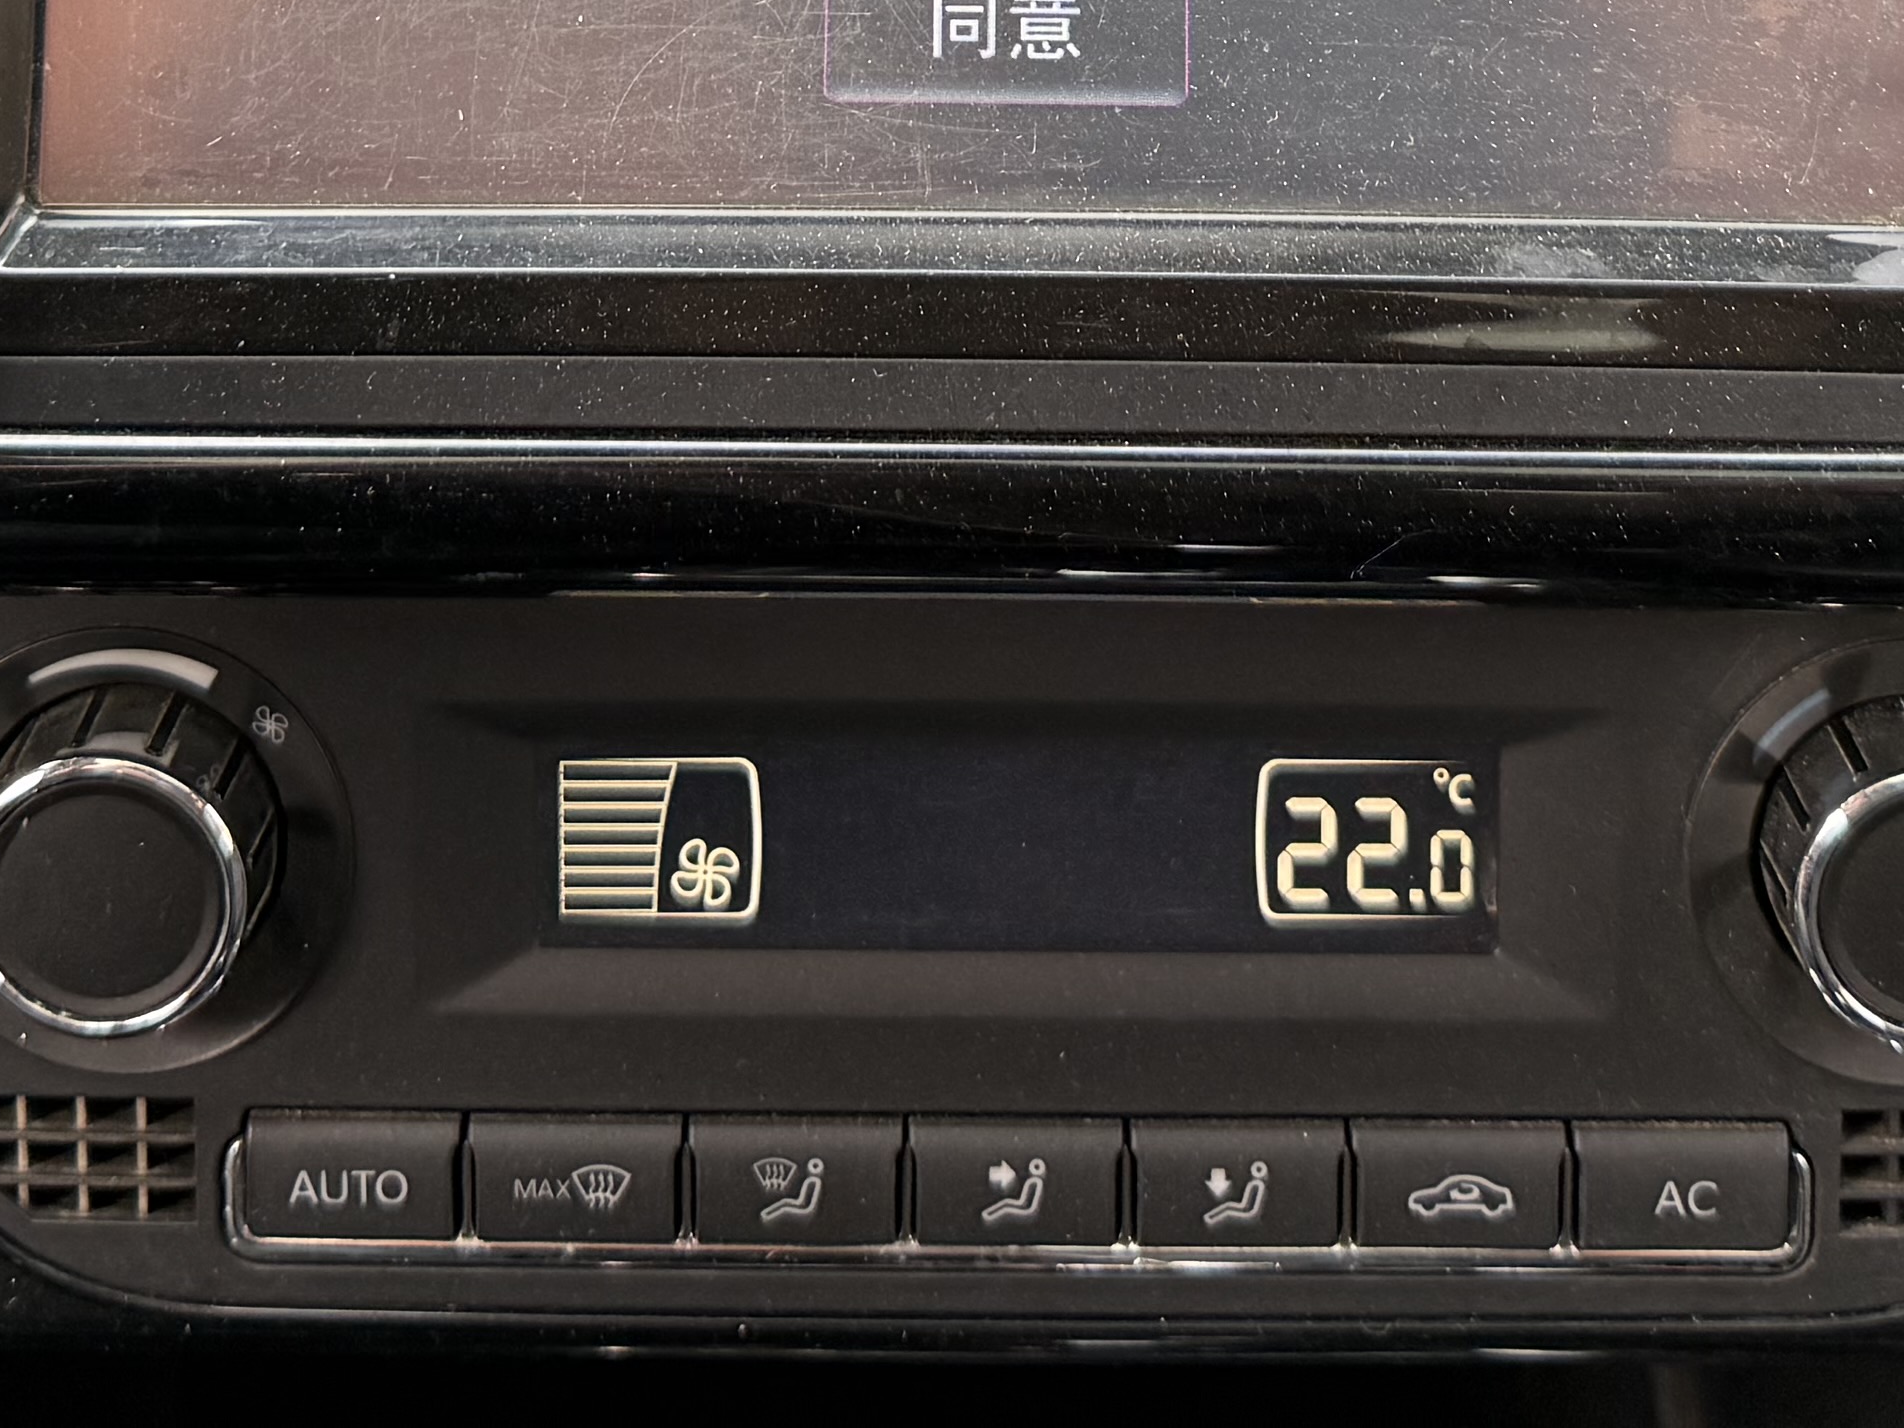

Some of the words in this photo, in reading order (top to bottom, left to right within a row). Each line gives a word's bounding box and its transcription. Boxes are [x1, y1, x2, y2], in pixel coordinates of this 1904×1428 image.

[1277, 797, 1474, 909] 22.0
[290, 1170, 408, 1204] AUTO
[514, 1179, 570, 1199] MAX
[1655, 1181, 1717, 1217] AC
